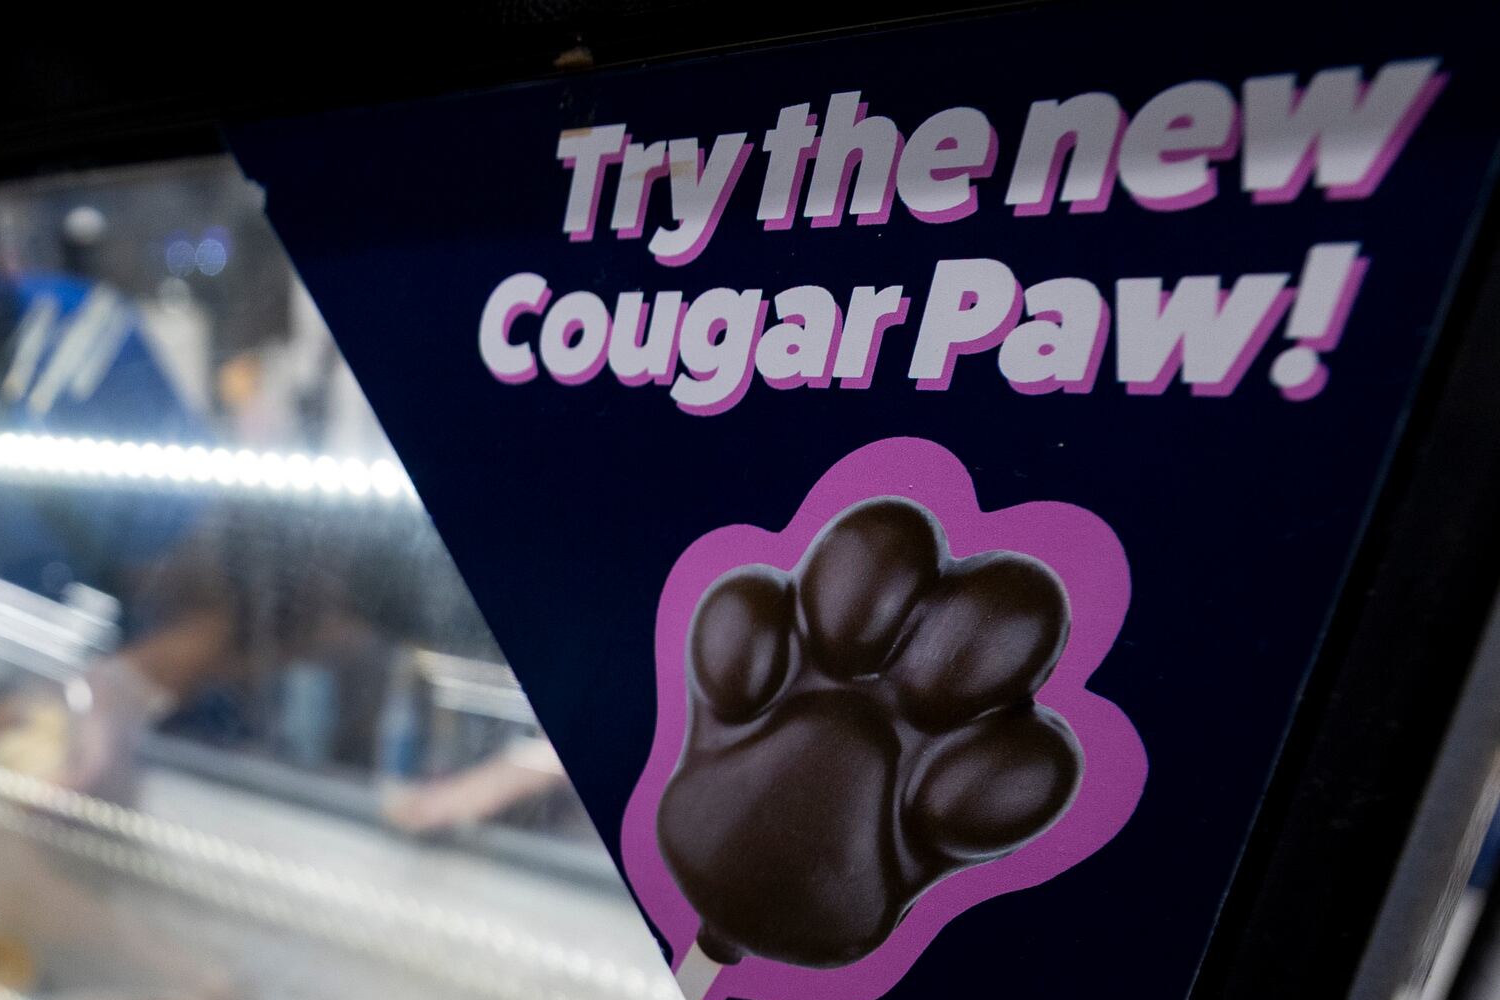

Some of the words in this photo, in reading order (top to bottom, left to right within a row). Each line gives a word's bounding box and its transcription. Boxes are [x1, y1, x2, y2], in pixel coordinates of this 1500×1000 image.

[556, 123, 752, 265] Try
[756, 90, 996, 230] the
[1004, 57, 1449, 215] new
[478, 272, 909, 416] Cougar
[908, 242, 1369, 398] Paw!
